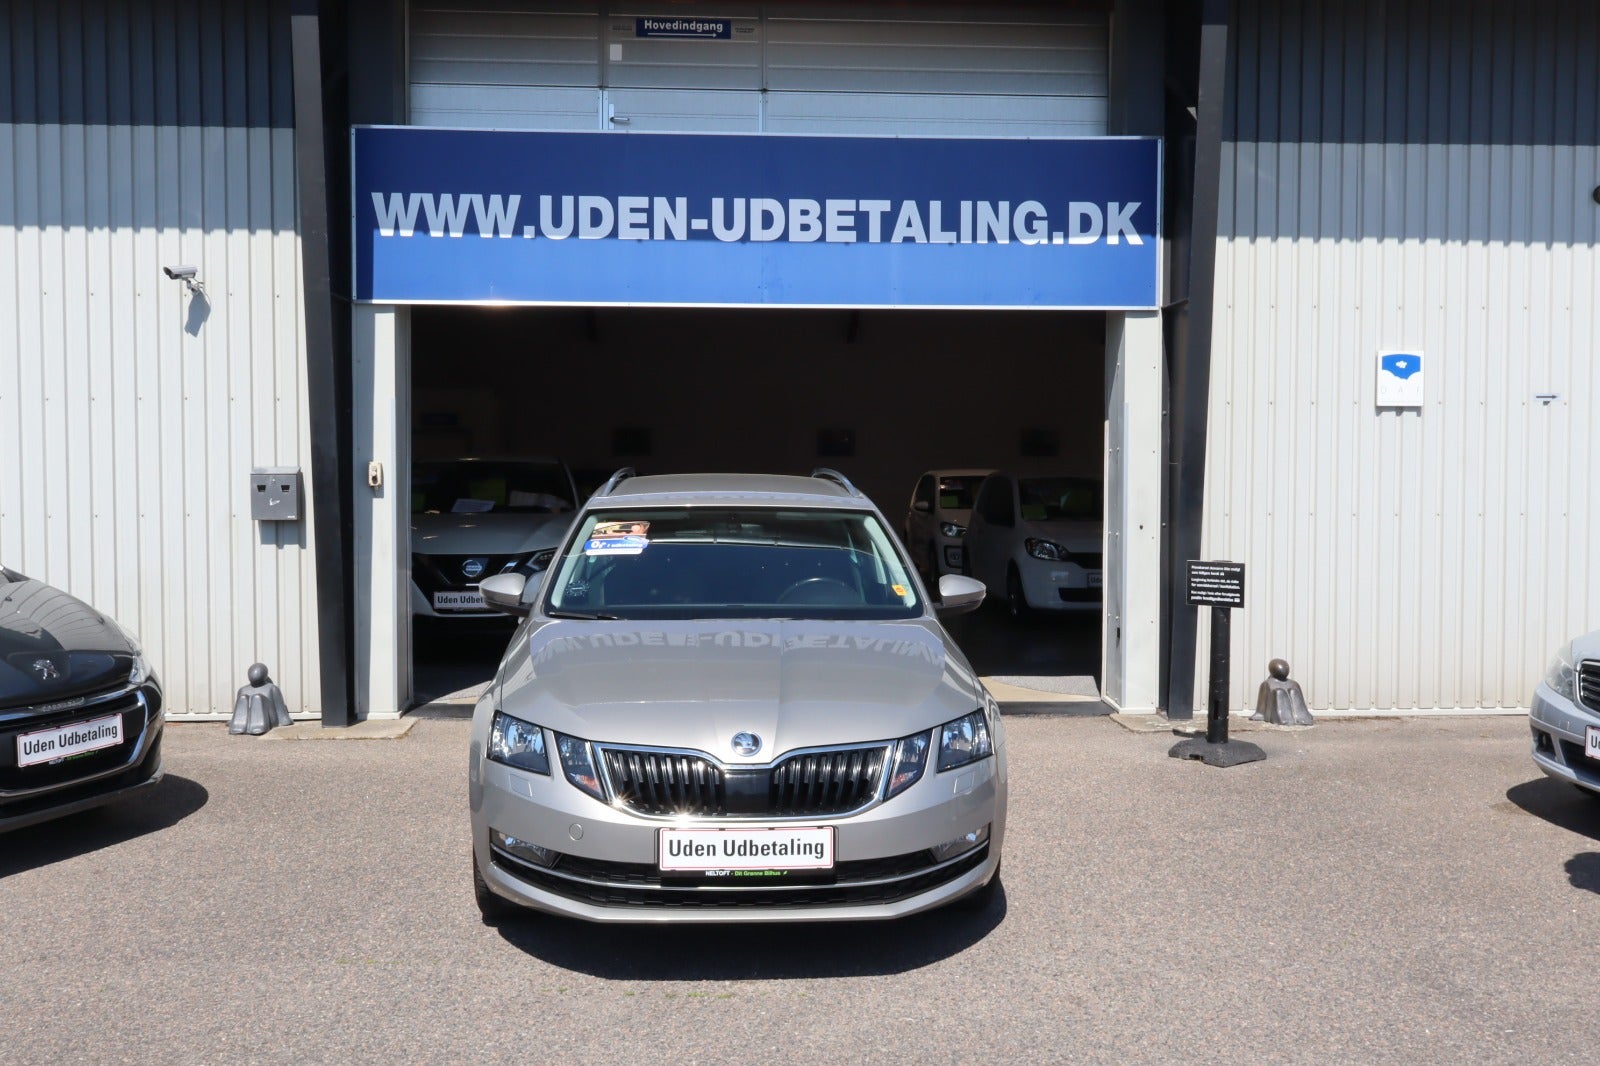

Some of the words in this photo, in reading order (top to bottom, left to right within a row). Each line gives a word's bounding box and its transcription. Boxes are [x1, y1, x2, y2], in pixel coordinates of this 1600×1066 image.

[644, 20, 723, 32] Hovedindgang
[372, 192, 1144, 246] WWW.UDEN-UDBETALING.DK
[437, 595, 458, 604] Uden
[24, 739, 55, 756] Uden
[59, 725, 118, 748] Udbetaling
[669, 839, 717, 857] Uden
[723, 838, 825, 859] Udbetaling
